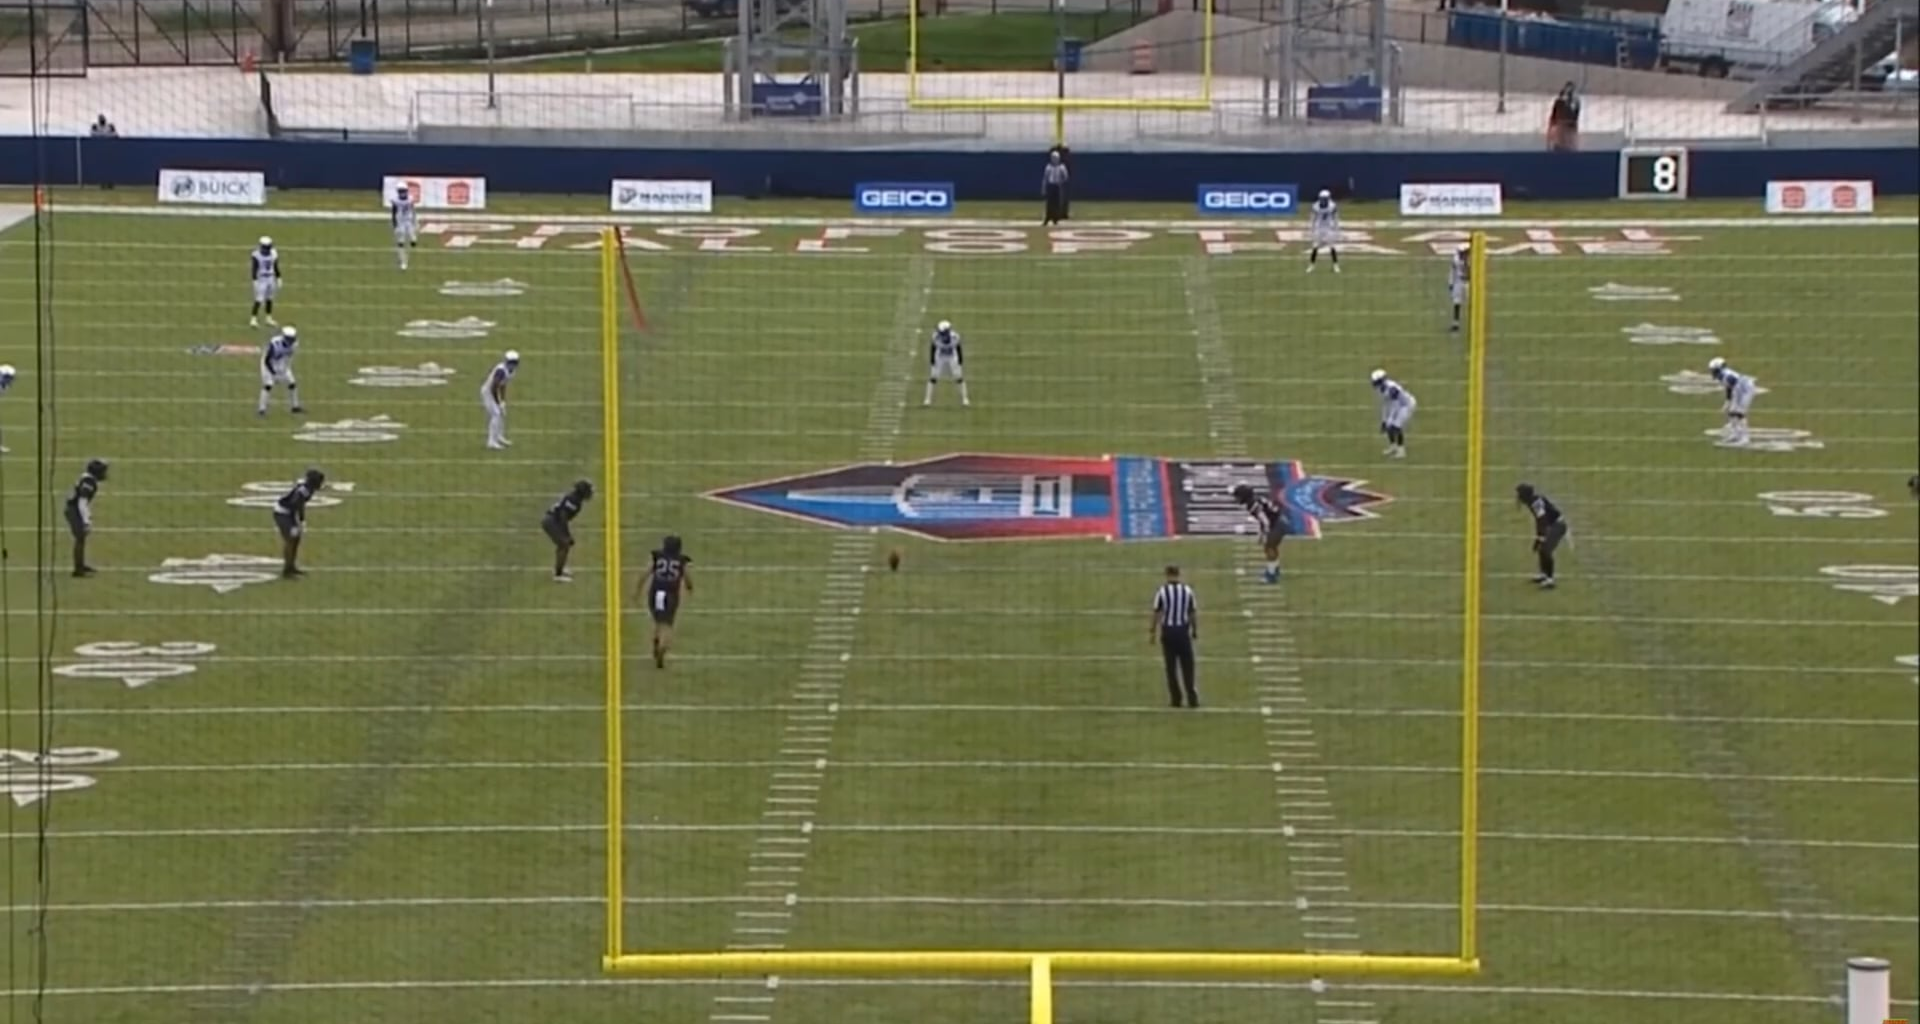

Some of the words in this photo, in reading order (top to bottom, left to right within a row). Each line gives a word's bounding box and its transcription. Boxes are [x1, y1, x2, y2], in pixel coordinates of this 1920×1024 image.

[1653, 156, 1676, 191] 8
[199, 180, 250, 196] BUICK
[862, 190, 947, 207] GEICO
[1205, 192, 1291, 208] GEICO
[823, 225, 1702, 241] FOOTBALL
[923, 240, 1134, 254] OF
[655, 558, 681, 580] 25
[51, 640, 217, 679] 30
